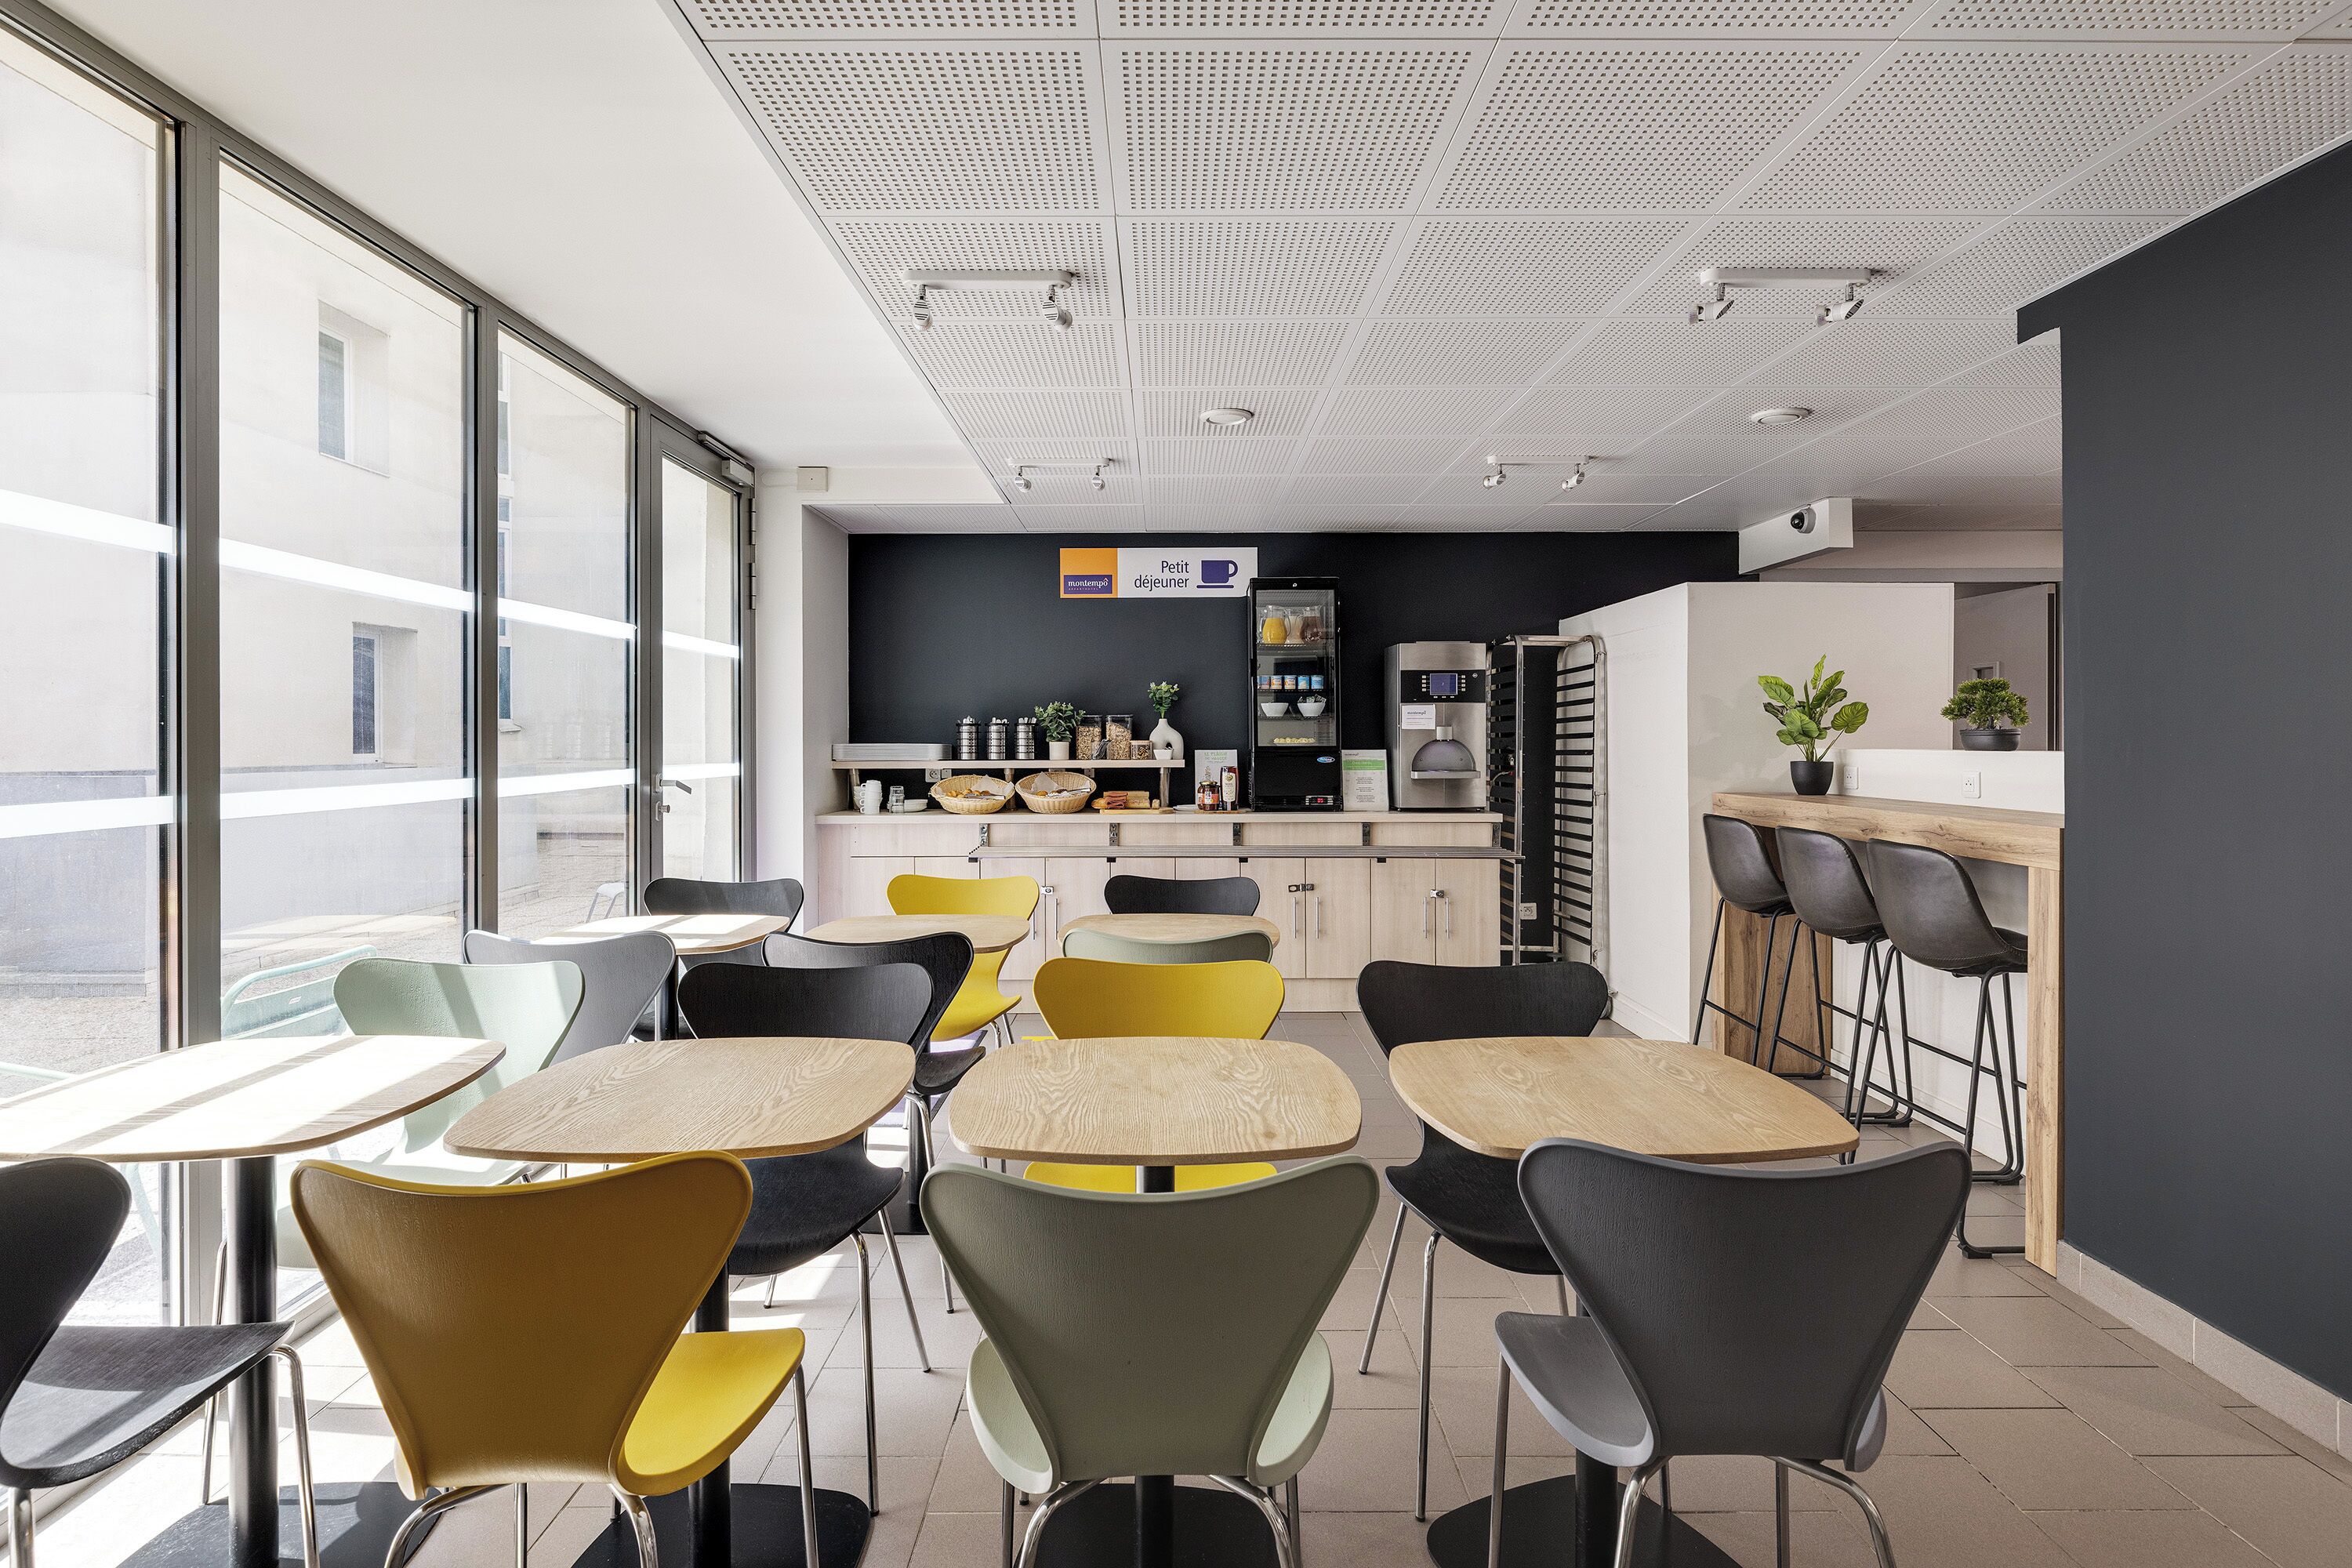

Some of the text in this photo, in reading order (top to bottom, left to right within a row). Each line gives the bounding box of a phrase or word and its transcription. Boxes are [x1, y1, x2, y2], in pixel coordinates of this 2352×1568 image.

[1161, 560, 1189, 573] Petit
[1068, 577, 1109, 588] montempô
[1134, 575, 1189, 591] déjeuner
